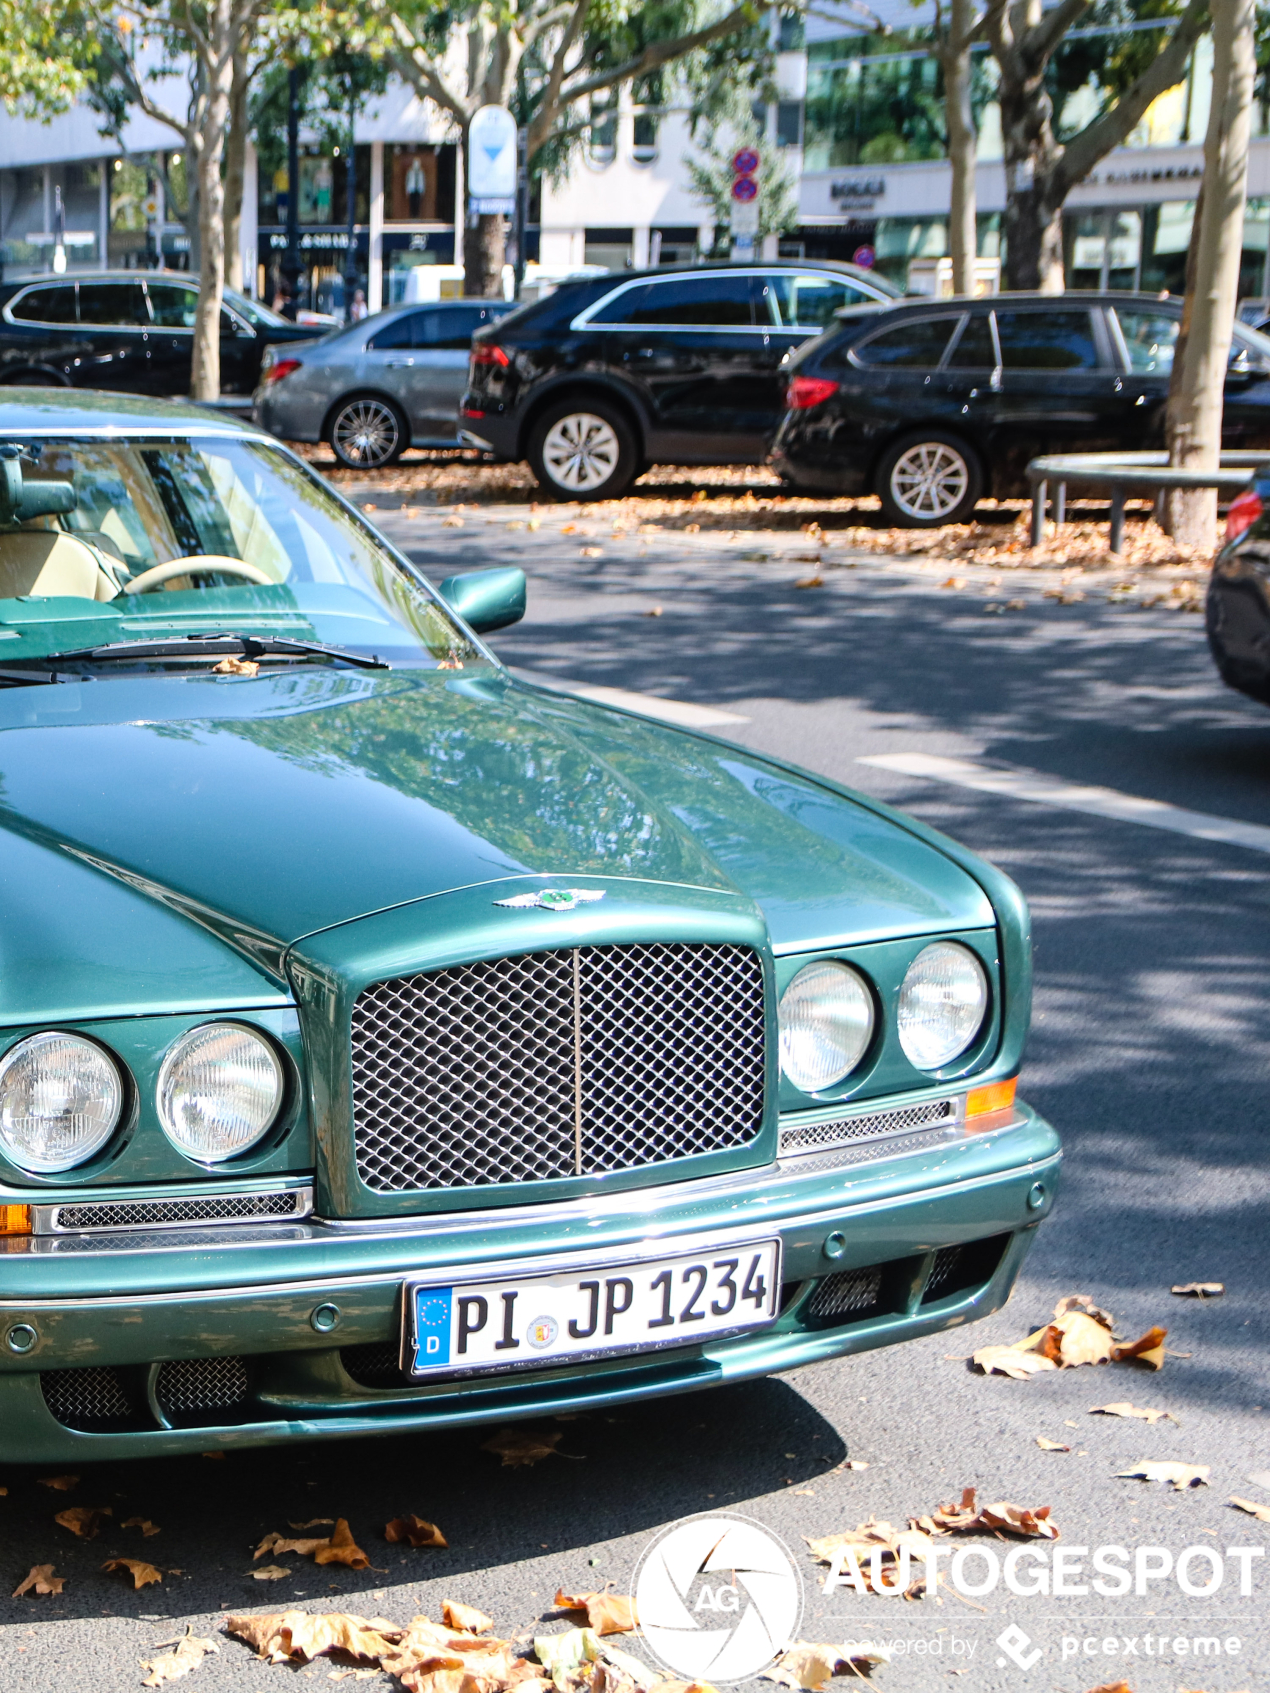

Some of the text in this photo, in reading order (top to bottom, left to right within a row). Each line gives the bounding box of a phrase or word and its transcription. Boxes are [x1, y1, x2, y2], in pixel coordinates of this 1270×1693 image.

[457, 1291, 520, 1354] PI
[568, 1277, 633, 1339] JP
[648, 1254, 766, 1329] 1234
[426, 1336, 440, 1354] D
